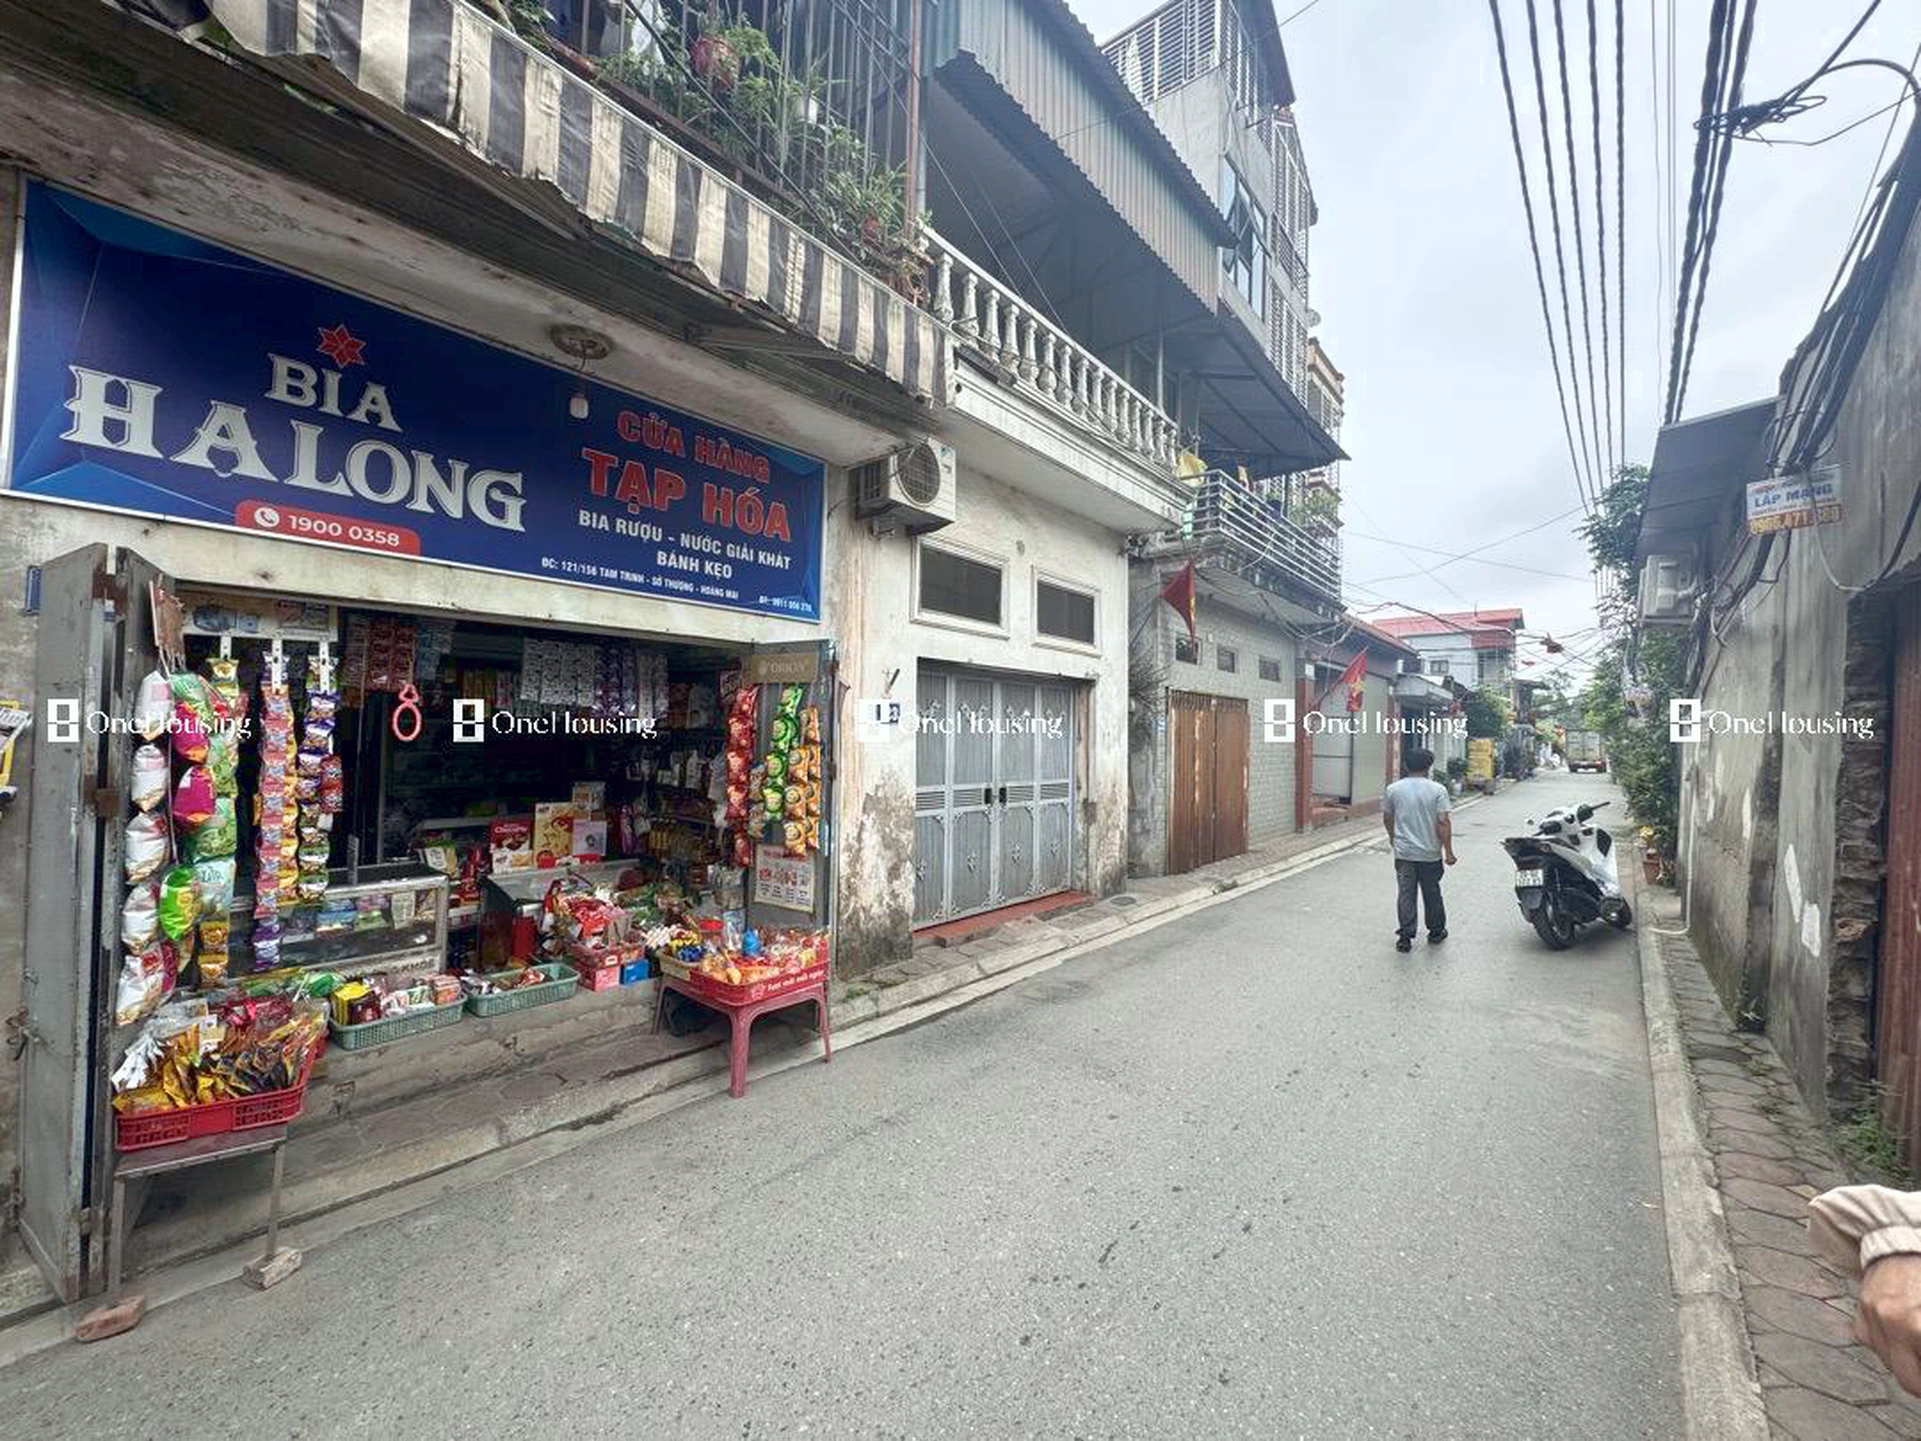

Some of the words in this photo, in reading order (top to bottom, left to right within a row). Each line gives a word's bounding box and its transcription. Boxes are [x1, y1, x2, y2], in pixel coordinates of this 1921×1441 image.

[264, 353, 403, 433] BIA
[617, 410, 686, 458] CỬA
[694, 436, 770, 484] HÀNG
[581, 447, 686, 515] TẠP
[702, 482, 792, 542] HÓA
[288, 514, 342, 537] 1900
[348, 526, 400, 547] 0358
[578, 509, 610, 531] BIA
[615, 518, 663, 543] RƯỢU
[680, 532, 721, 556] NƯỚC
[726, 542, 754, 562] GIẢI
[757, 551, 792, 570] KHÁT
[600, 567, 618, 579] TAM
[656, 550, 700, 573] BÁNH
[704, 559, 733, 580] KẸO
